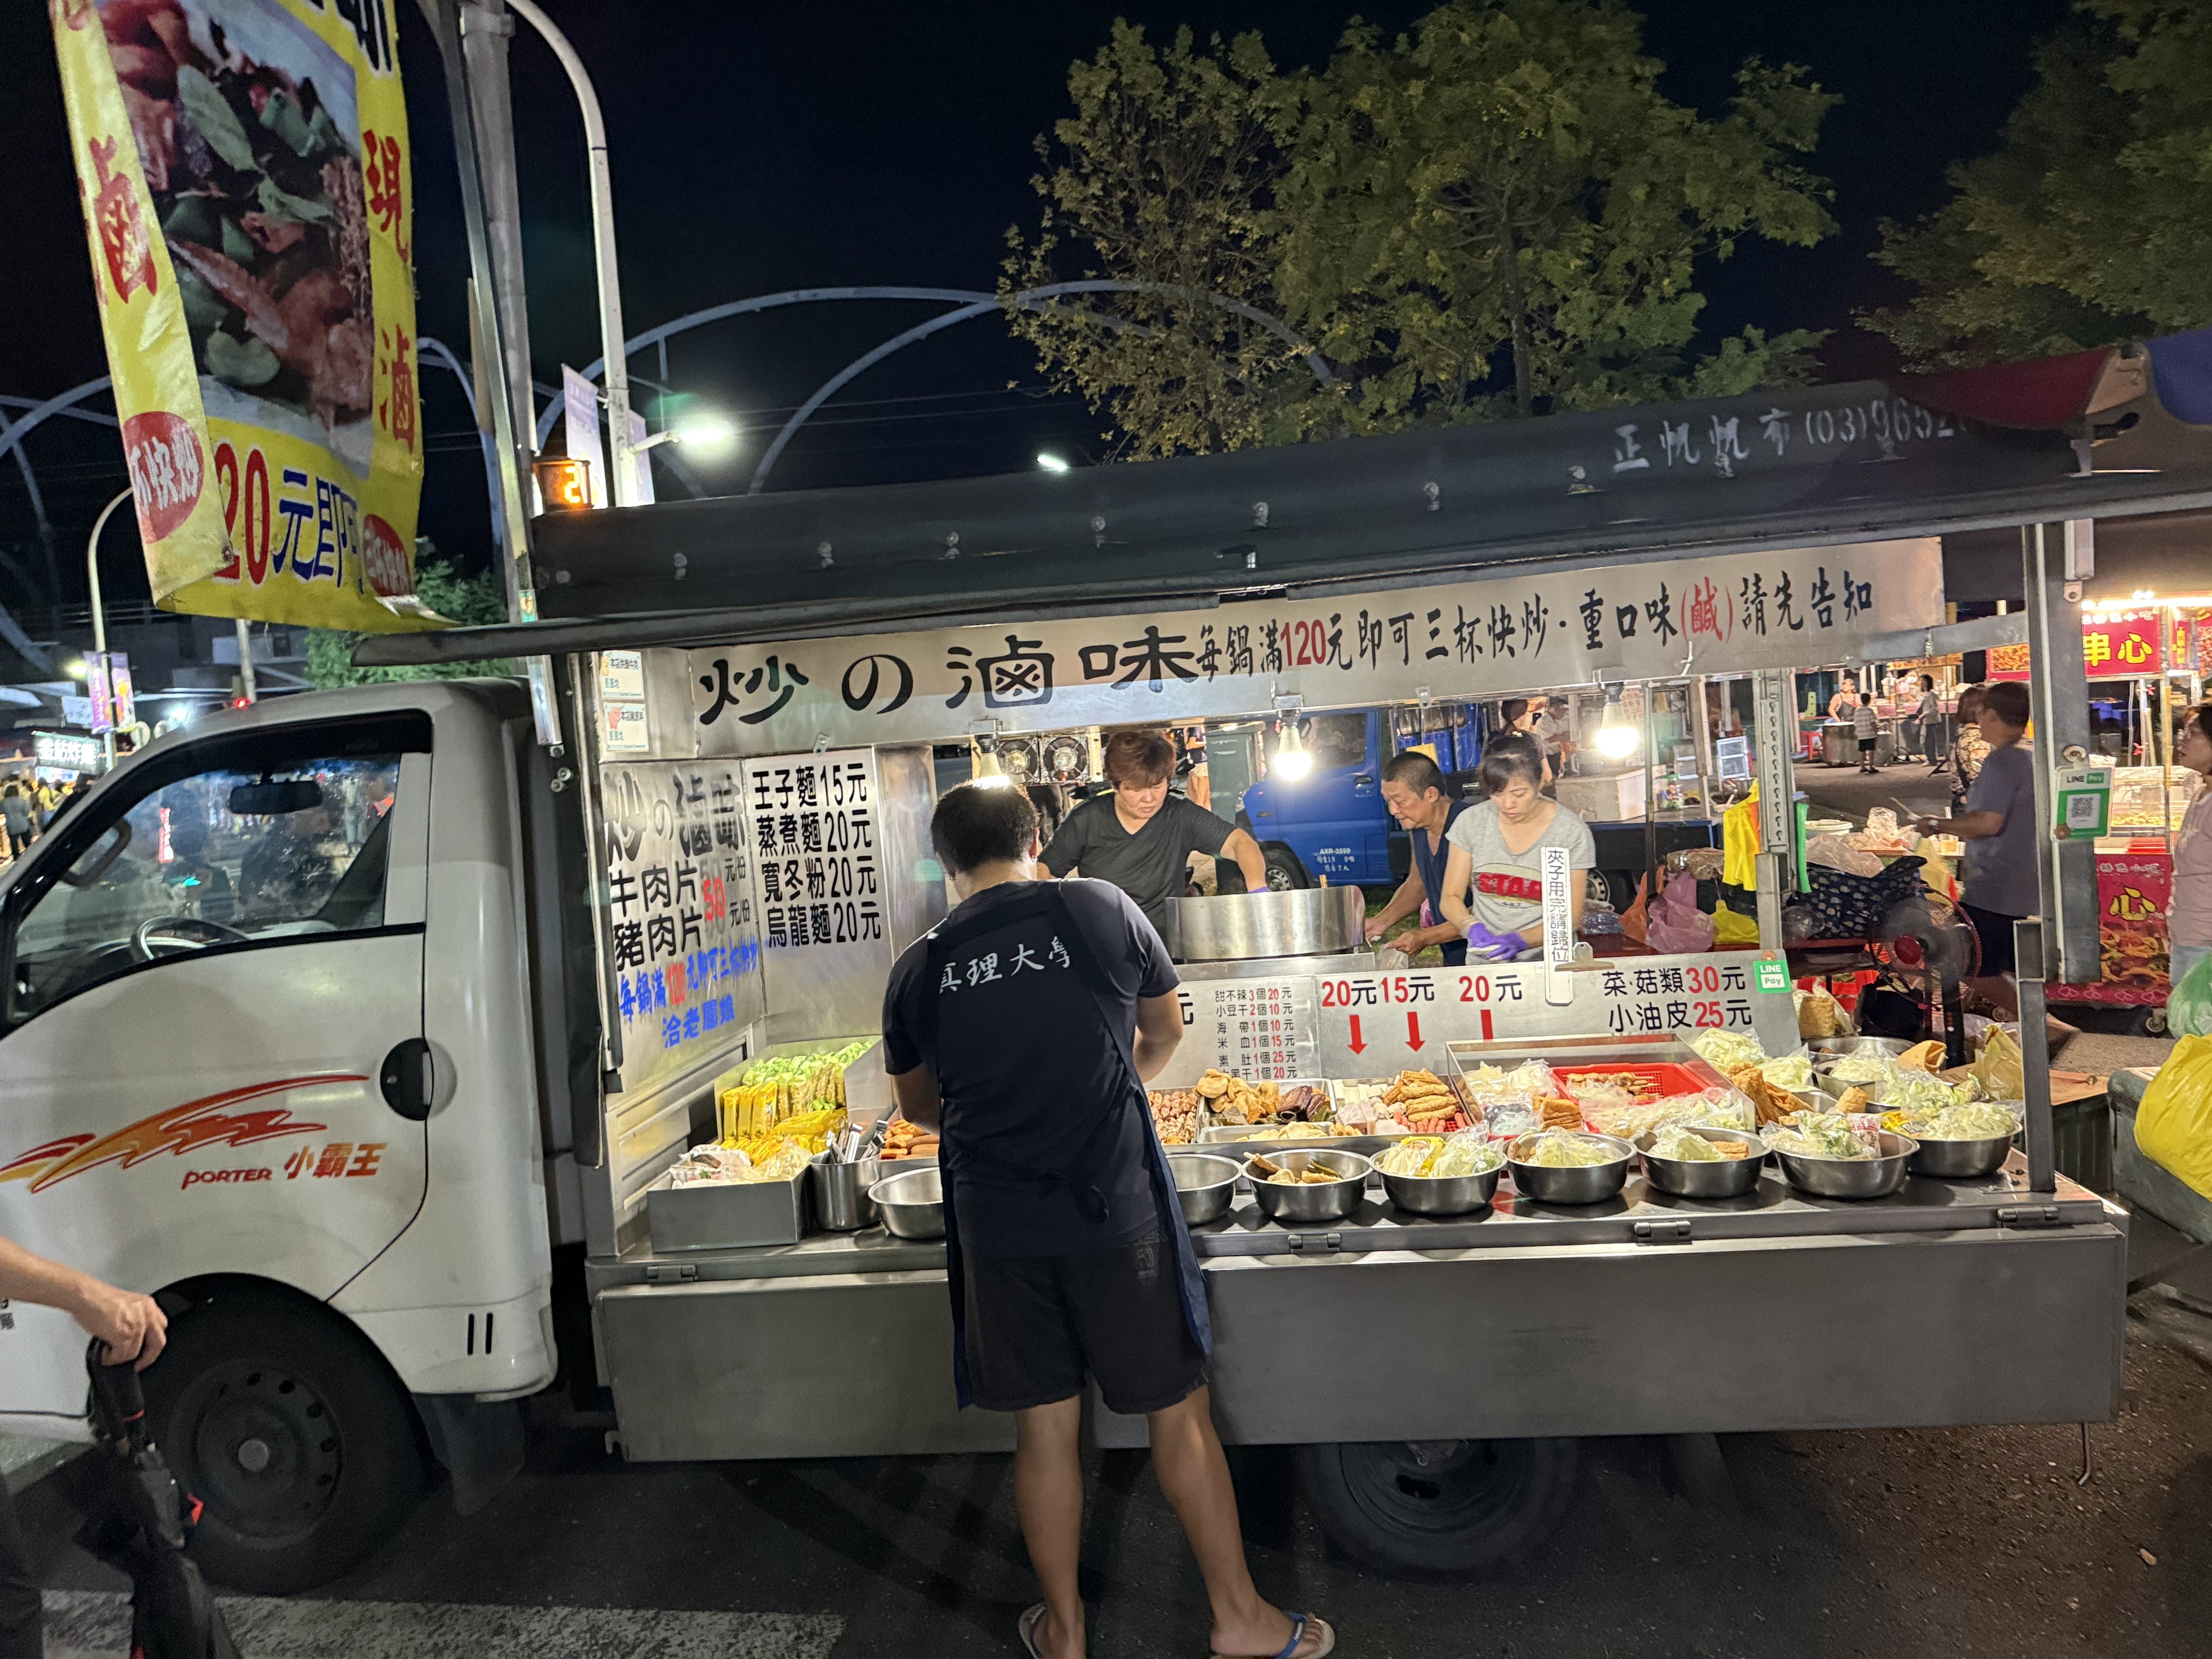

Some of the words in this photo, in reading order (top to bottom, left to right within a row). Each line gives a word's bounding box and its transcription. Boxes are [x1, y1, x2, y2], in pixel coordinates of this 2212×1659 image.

[700, 625, 1200, 725] 炒の滷味
[752, 763, 867, 810] 王子麵15元
[756, 808, 872, 858] 蒸煮麵20元
[609, 859, 698, 917] 牛肉片
[761, 855, 876, 903] 寬冬粉20元
[613, 905, 702, 972] 豬肉片
[939, 935, 1070, 994] 真理大學
[1759, 964, 1782, 973] LINE
[1764, 977, 1781, 986] Pay
[1322, 979, 1377, 1007] 20元
[1380, 975, 1435, 1004] 15元
[1459, 974, 1522, 1003] 20元
[1609, 999, 1752, 1032] 小油皮25元
[180, 1167, 272, 1190] PORTER
[283, 1142, 388, 1180] 小霸王
